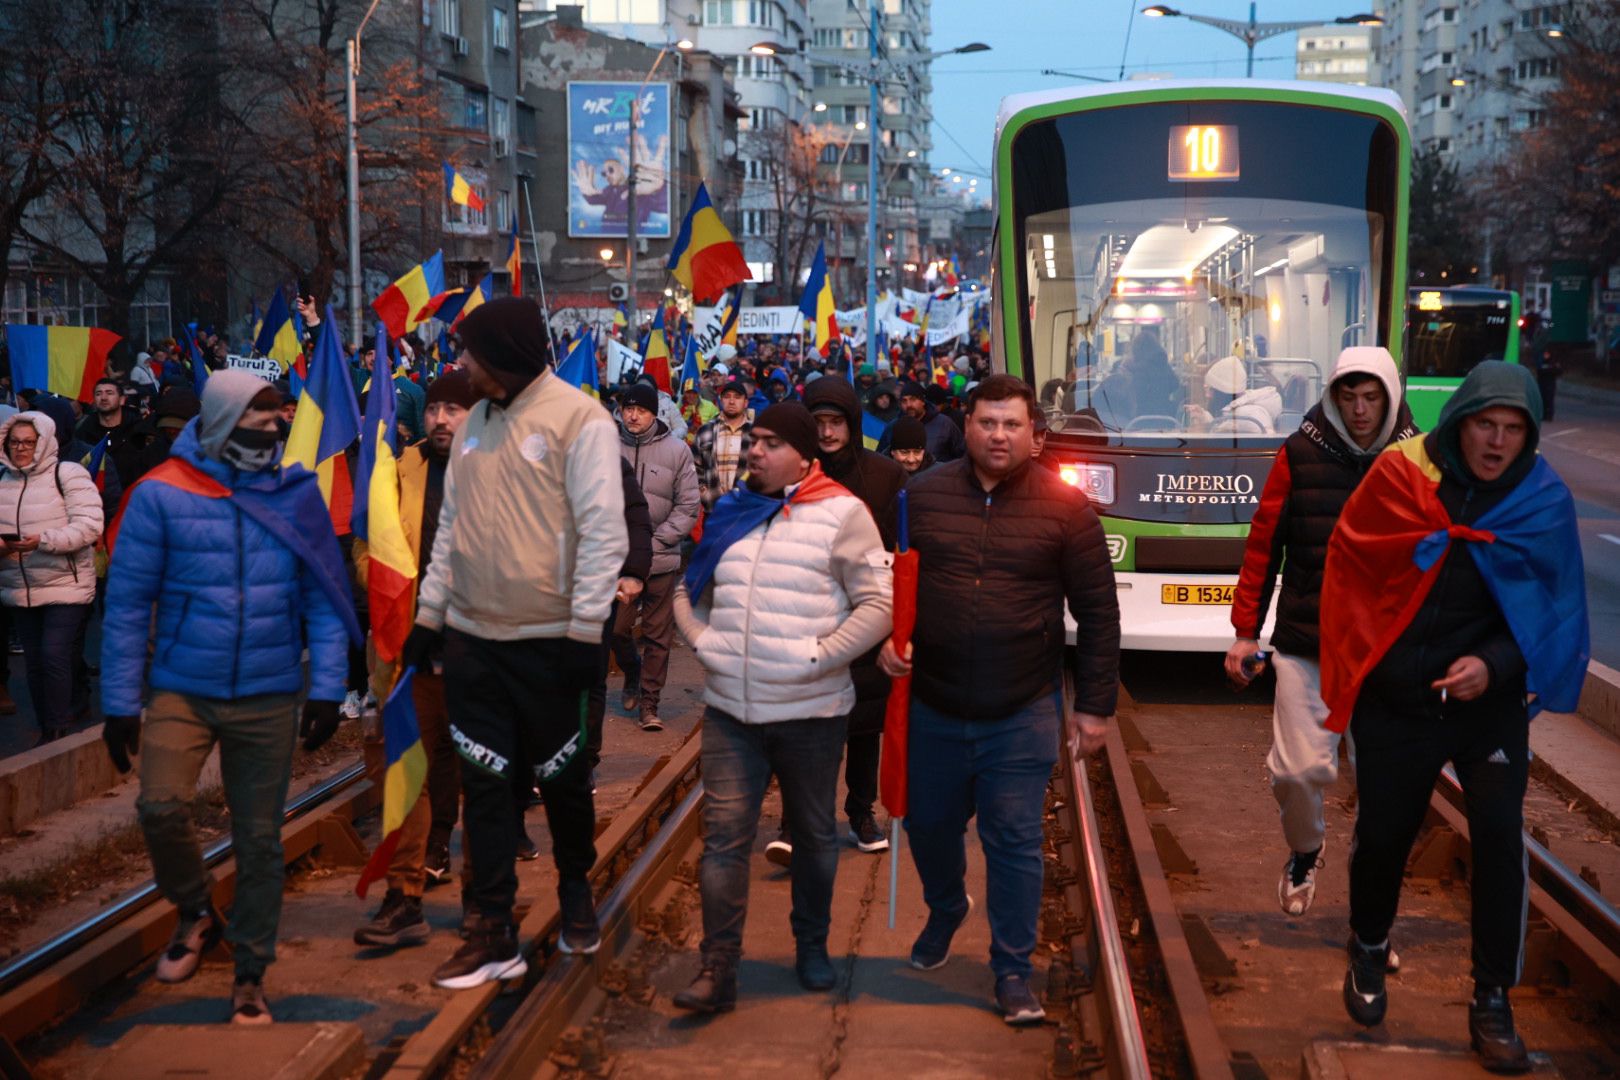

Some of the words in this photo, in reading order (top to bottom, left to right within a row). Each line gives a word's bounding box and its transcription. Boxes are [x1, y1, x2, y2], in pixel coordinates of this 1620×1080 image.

[1185, 127, 1219, 172] 10
[229, 357, 265, 370] Turul
[1155, 474, 1254, 494] IMPERIO
[1139, 493, 1260, 504] METROPOLITA
[1177, 586, 1189, 602] B
[1196, 587, 1238, 602] 1534
